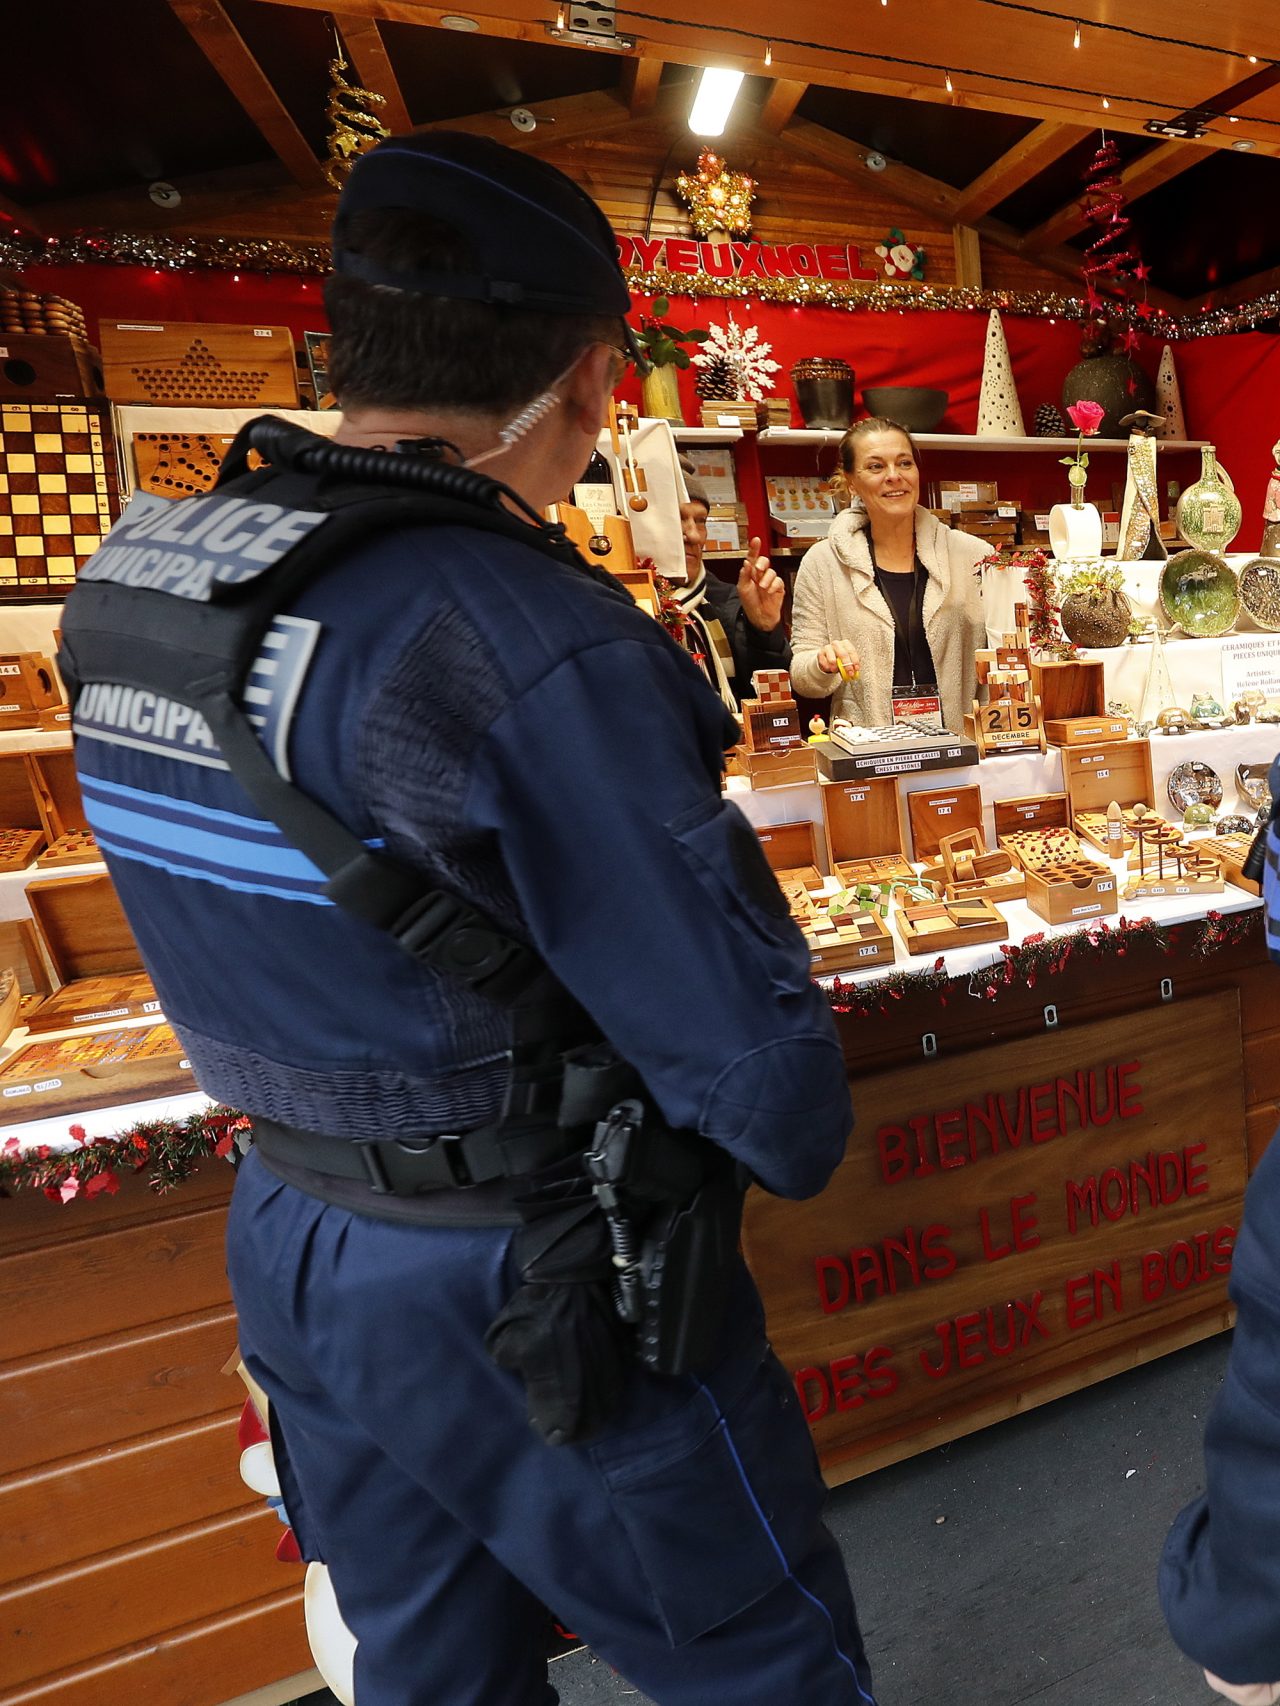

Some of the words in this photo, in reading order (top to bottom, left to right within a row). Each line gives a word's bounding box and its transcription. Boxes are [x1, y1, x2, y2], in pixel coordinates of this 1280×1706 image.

[113, 494, 331, 563] POLICE
[1221, 641, 1265, 651] CERAMIQUES
[1267, 639, 1276, 647] ET
[1233, 651, 1256, 660] PIECES
[74, 683, 221, 752] UNICIPA
[991, 731, 1030, 740] DECEMBRE
[857, 758, 886, 768] ECHIQUIER
[921, 752, 940, 760] GALETS
[876, 765, 893, 773] CHESS
[900, 763, 921, 771] STONES
[860, 948, 869, 956] 17
[145, 1002, 157, 1011] 17
[876, 1060, 1145, 1185] BIENVENUE
[815, 1222, 958, 1314] DANS
[978, 1192, 1041, 1262] LE
[1065, 1142, 1210, 1235] MONDE
[793, 1344, 901, 1424] DES
[919, 1290, 1053, 1379] JEUX
[1064, 1259, 1123, 1329] EN
[1140, 1224, 1237, 1301] BOIS
